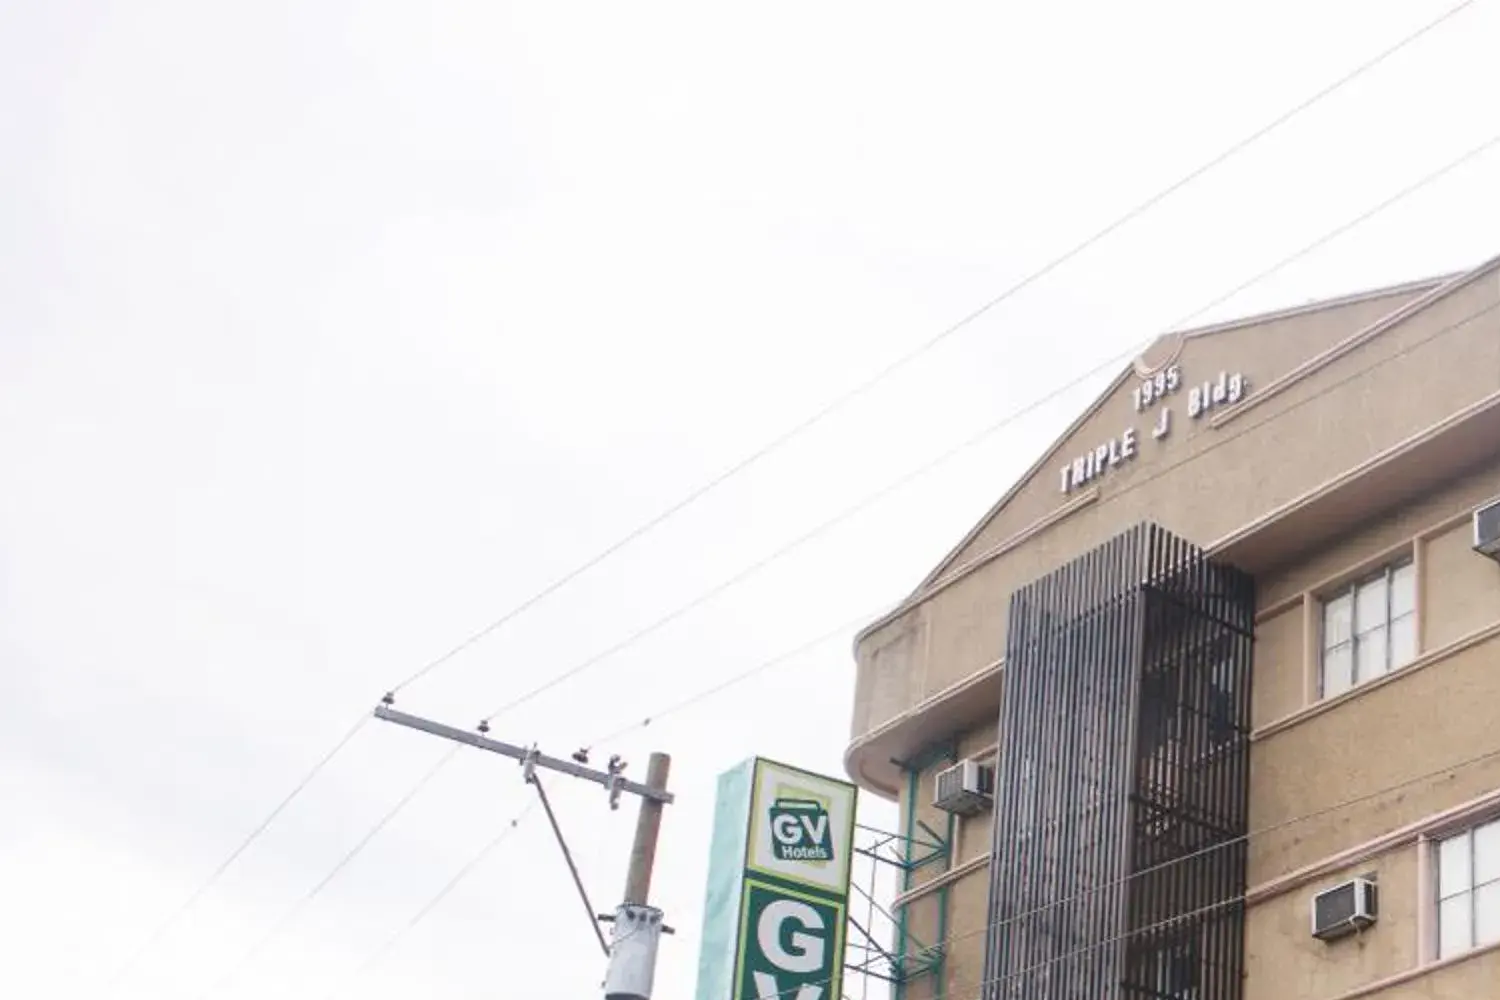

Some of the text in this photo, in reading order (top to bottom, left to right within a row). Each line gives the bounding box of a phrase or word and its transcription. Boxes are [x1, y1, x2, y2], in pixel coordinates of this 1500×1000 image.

[1134, 366, 1180, 410] 1995
[1059, 428, 1137, 492] TRIPLE
[1152, 407, 1172, 441] J
[773, 813, 827, 845] GV
[780, 845, 829, 859] Hotels
